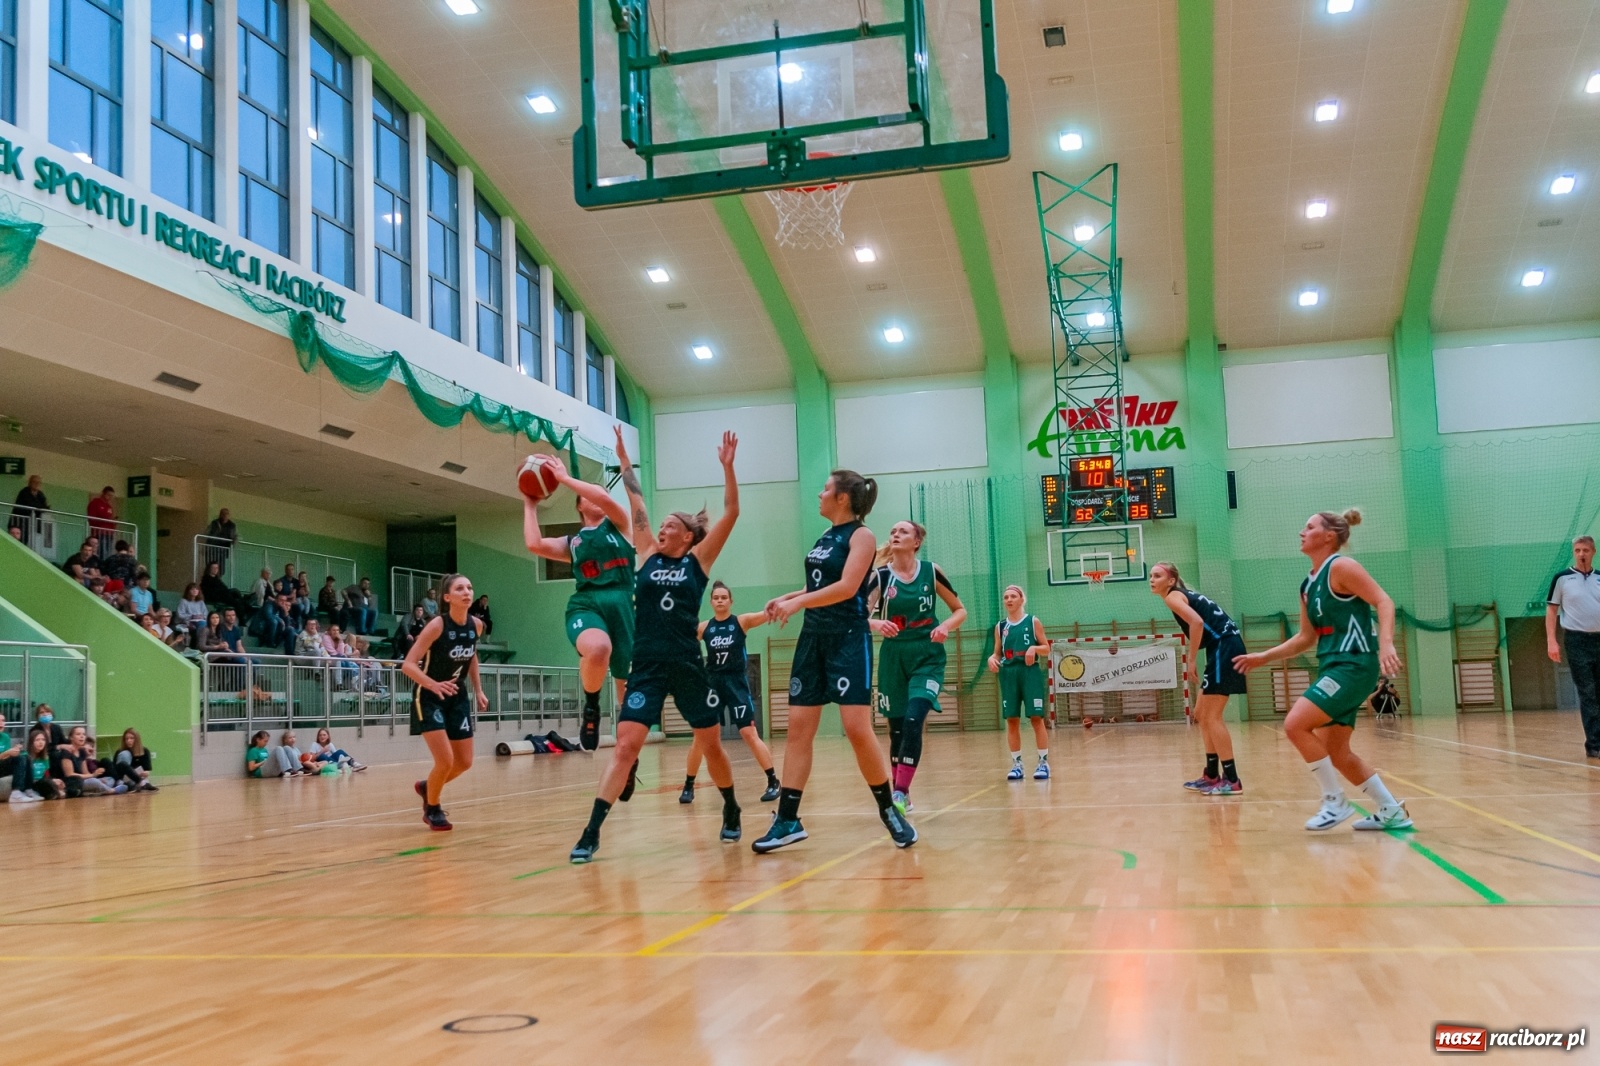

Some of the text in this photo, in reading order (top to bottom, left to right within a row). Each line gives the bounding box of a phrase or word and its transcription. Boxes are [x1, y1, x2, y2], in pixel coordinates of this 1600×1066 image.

[34, 156, 135, 227] SPORTU
[141, 204, 148, 235] I
[155, 211, 261, 285] REKREACJI
[266, 263, 346, 323] RACIBÓRZ
[1087, 471, 1104, 486] 10
[133, 483, 146, 495] F
[1076, 508, 1093, 521] 52
[1131, 504, 1148, 518] 35
[605, 533, 619, 547] 4
[811, 568, 822, 587] 9
[660, 591, 675, 611] 6
[918, 594, 933, 613] 24
[710, 634, 735, 647] Stal
[1023, 633, 1030, 646] 5
[448, 644, 476, 658] Stal
[715, 651, 729, 665] 17
[1091, 672, 1111, 685] JEST
[1111, 669, 1120, 678] W
[837, 676, 850, 697] 9
[706, 688, 720, 708] 6
[733, 704, 747, 719] 17
[460, 716, 470, 732] 4
